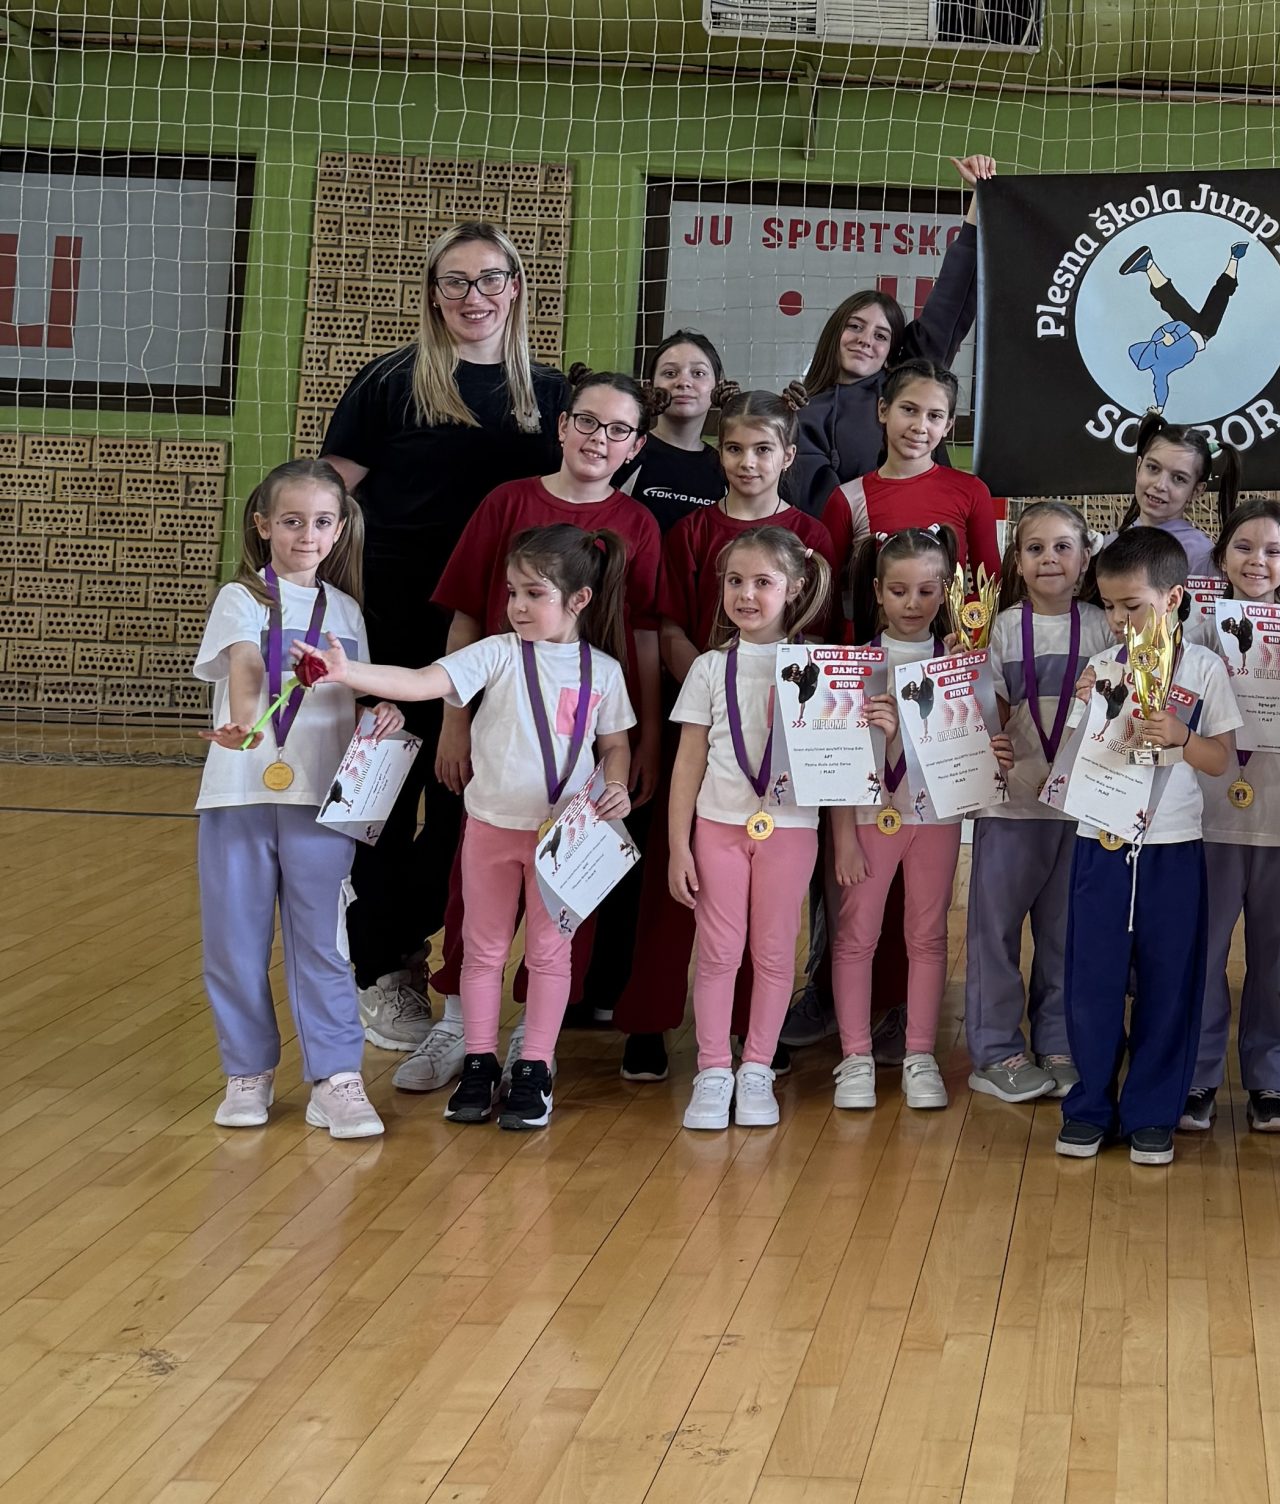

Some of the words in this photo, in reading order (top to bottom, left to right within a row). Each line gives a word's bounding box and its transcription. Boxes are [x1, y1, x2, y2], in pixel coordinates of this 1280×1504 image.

[684, 215, 733, 246] JU
[1036, 232, 1100, 338] Plesna
[1088, 184, 1183, 238] škola
[1190, 183, 1280, 243] Jump
[650, 490, 688, 501] TOKYO
[1187, 580, 1211, 589] NOVI
[1248, 607, 1271, 616] NOVI
[816, 650, 844, 660] NOVI
[832, 666, 865, 675] DANCE
[929, 661, 953, 673] NOVI
[944, 672, 972, 684] DANCE
[835, 681, 859, 689] NOW
[949, 688, 969, 698] NOW
